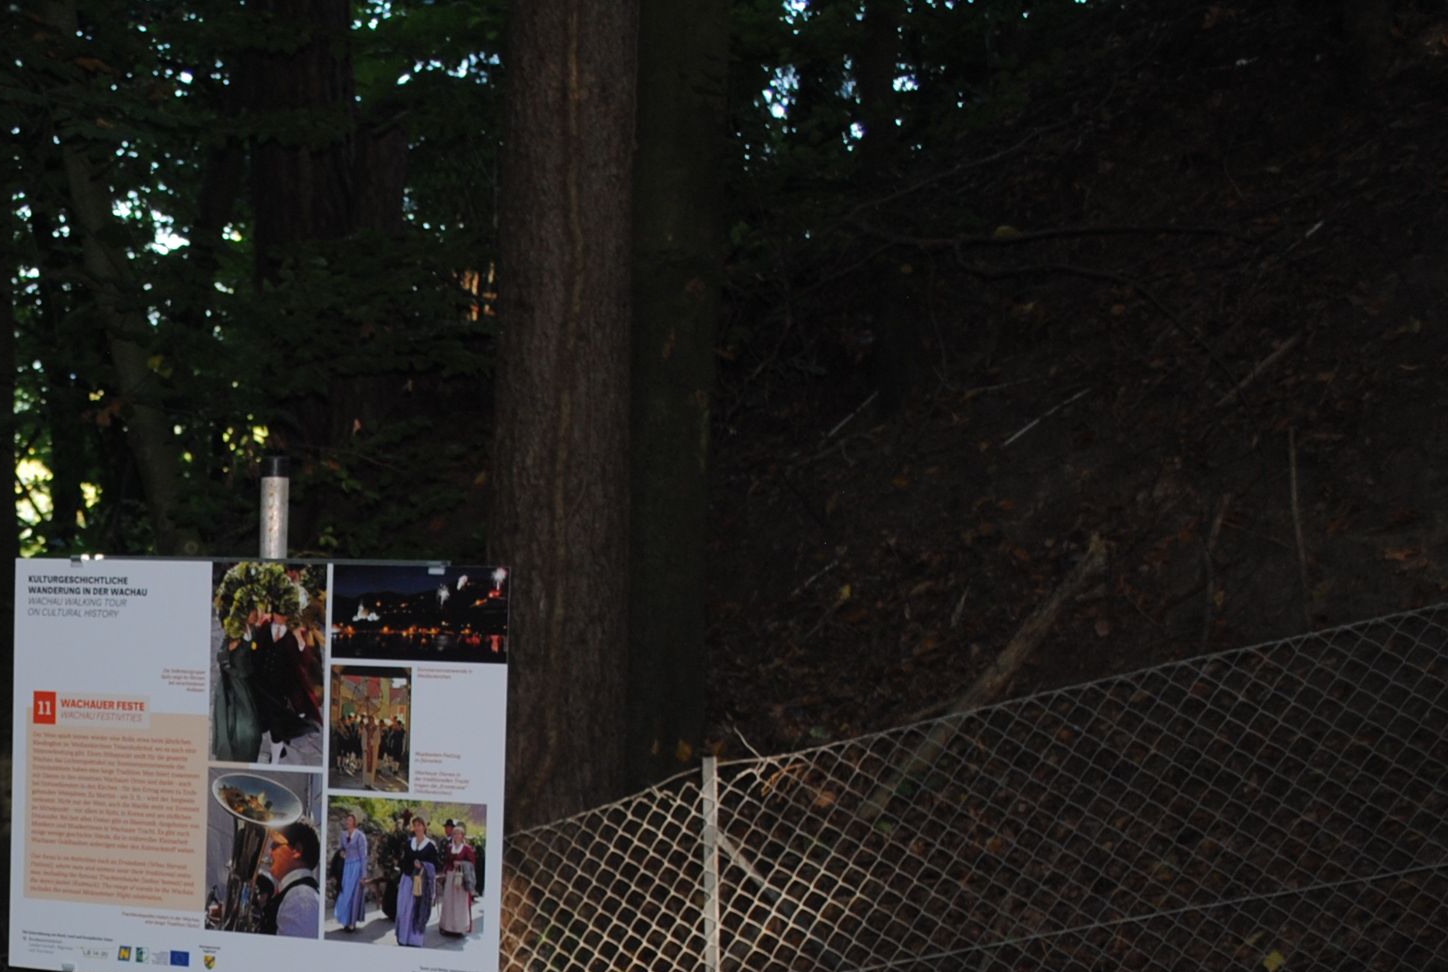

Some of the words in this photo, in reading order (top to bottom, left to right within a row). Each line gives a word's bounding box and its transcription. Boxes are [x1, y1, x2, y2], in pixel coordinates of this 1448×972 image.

[28, 575, 129, 585] KULTURGESCHICHTLICHE
[28, 586, 81, 595] WANDERUNG
[83, 587, 91, 595] IN
[92, 587, 109, 596] DER
[110, 588, 148, 597] WACHAU
[28, 597, 62, 606] WACHAU
[65, 598, 102, 607] WALKING
[105, 598, 127, 608] TOUR
[27, 607, 40, 616] ON
[42, 608, 83, 617] CULTURAL
[84, 609, 120, 618] HISTORY
[37, 700, 52, 716] 11
[60, 699, 115, 710] WACHAUER
[116, 700, 145, 711] FESTE
[60, 710, 96, 721] WACHAU
[96, 711, 143, 722] FESTIVITIES
